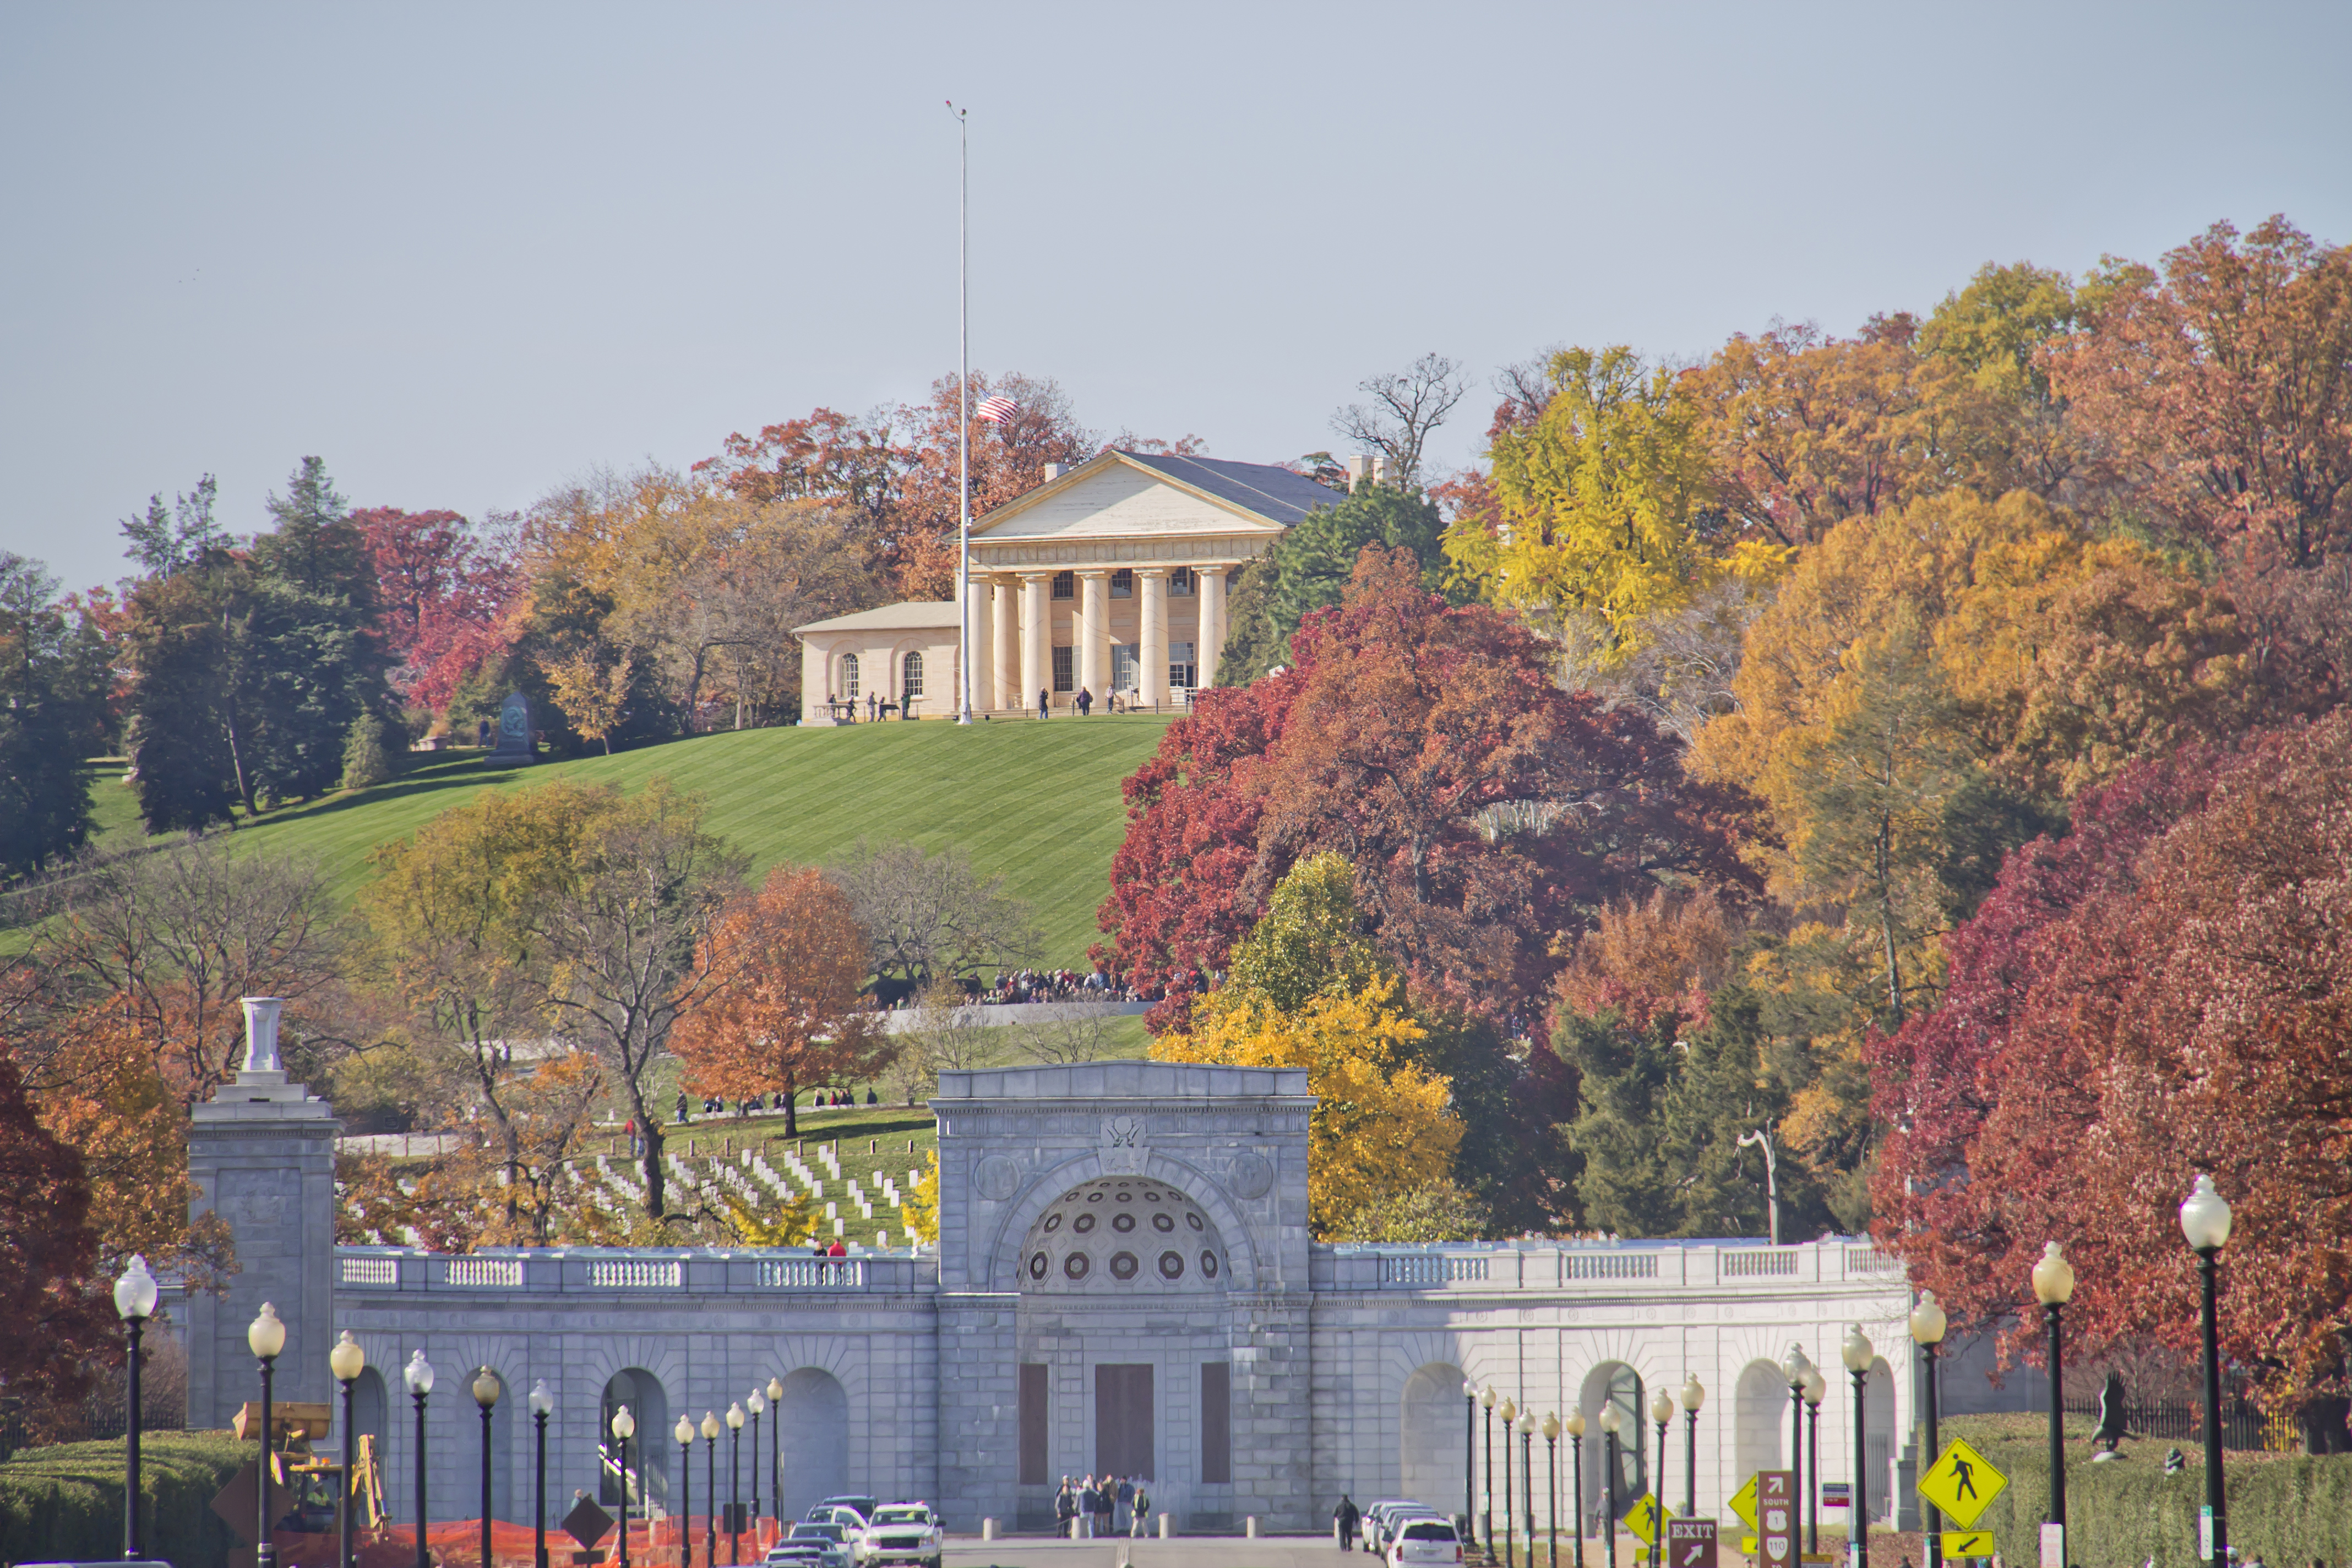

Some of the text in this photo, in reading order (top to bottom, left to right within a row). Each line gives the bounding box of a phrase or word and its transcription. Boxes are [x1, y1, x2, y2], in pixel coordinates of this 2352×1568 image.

[1774, 1516, 1778, 1525] 1
[1672, 1523, 1714, 1539] EXIT
[1769, 1542, 1785, 1550] 110
